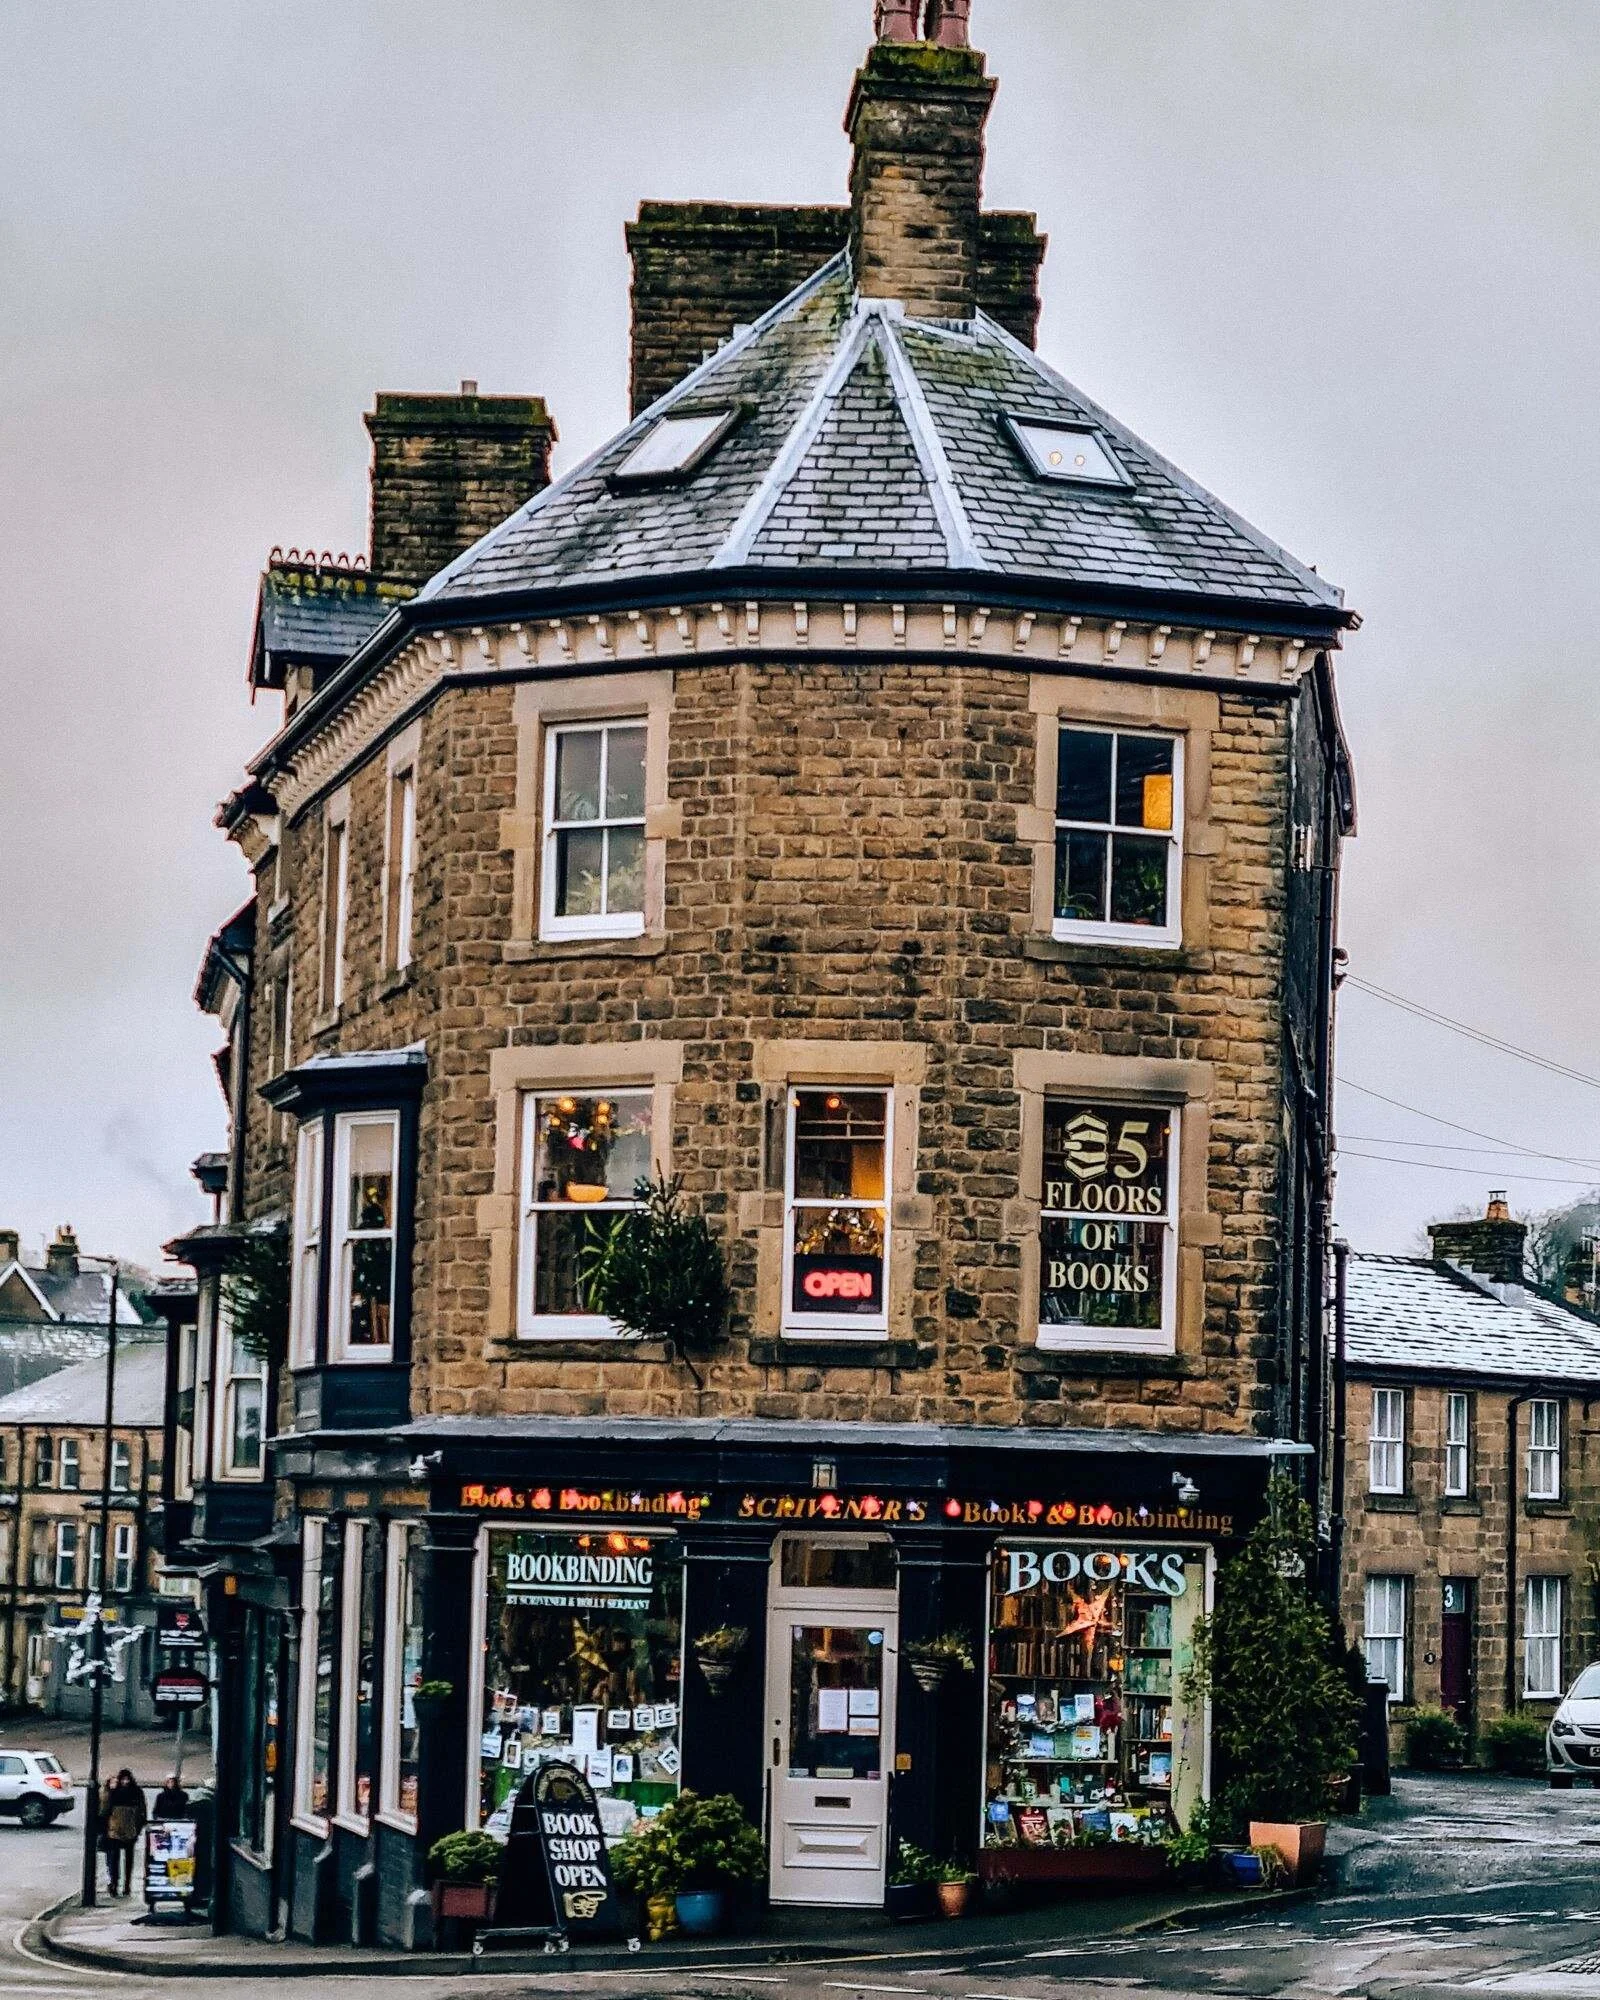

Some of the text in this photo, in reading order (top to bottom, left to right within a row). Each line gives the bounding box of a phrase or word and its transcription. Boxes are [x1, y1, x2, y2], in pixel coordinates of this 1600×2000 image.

[1114, 1121, 1150, 1178] 5
[1045, 1181, 1162, 1214] FLOORS
[1080, 1222, 1119, 1250] OF
[804, 1271, 872, 1297] OPEN
[1048, 1261, 1150, 1293] BOOKS
[738, 1497, 928, 1521] SCRIVENERS
[963, 1502, 1038, 1524] Books
[1047, 1503, 1075, 1525] &
[507, 1553, 653, 1584] BOOKBINDING
[1005, 1551, 1187, 1597] BOOKS
[1444, 1584, 1453, 1608] 3
[542, 1812, 600, 1835] BOOK
[548, 1838, 600, 1861] SHOP
[554, 1864, 607, 1887] OPEN
